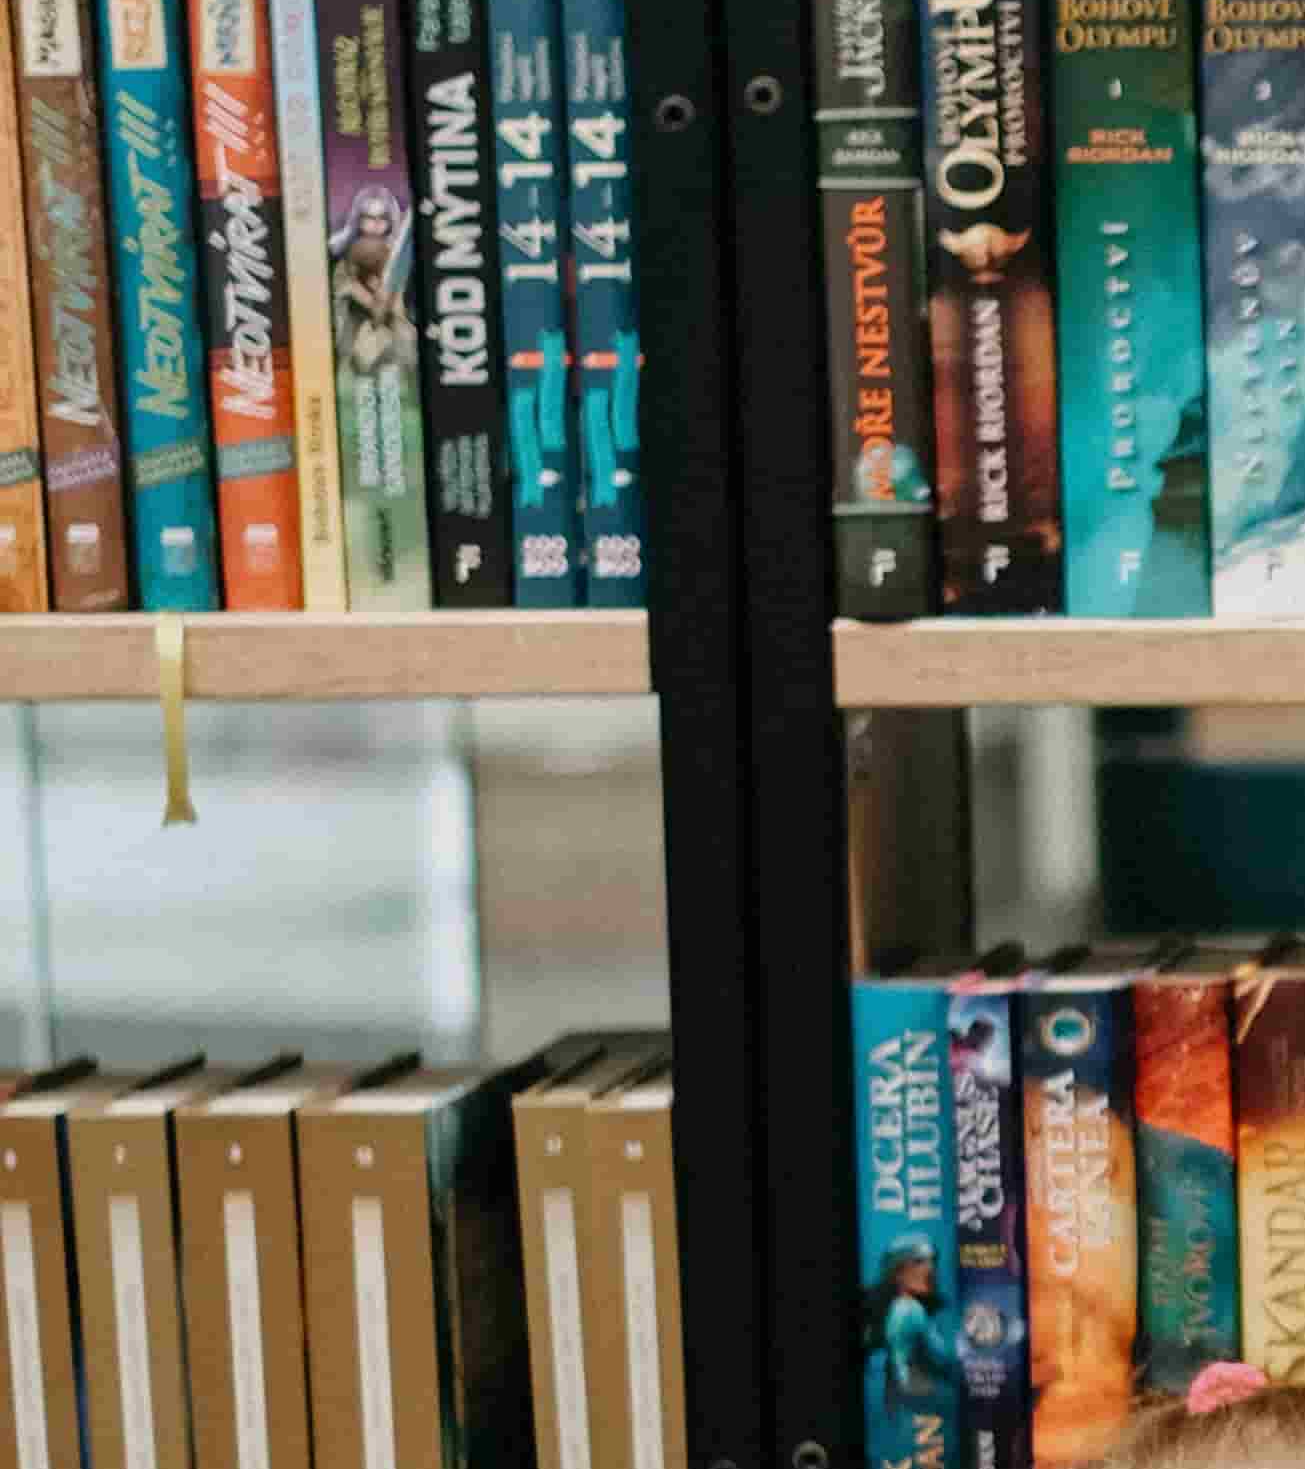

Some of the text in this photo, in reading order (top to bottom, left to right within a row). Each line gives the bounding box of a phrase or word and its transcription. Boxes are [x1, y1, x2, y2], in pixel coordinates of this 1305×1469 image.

[1056, 23, 1177, 53] OLYMPU
[418, 71, 484, 269] MÝTINA
[426, 277, 489, 386] KÓD
[845, 195, 892, 378] NESTVŮR
[972, 298, 1009, 524] RICK RIORDAN
[867, 1038, 906, 1212] DCERA
[903, 1029, 941, 1222] HLUBIN
[1042, 1070, 1079, 1275] CARTERA
